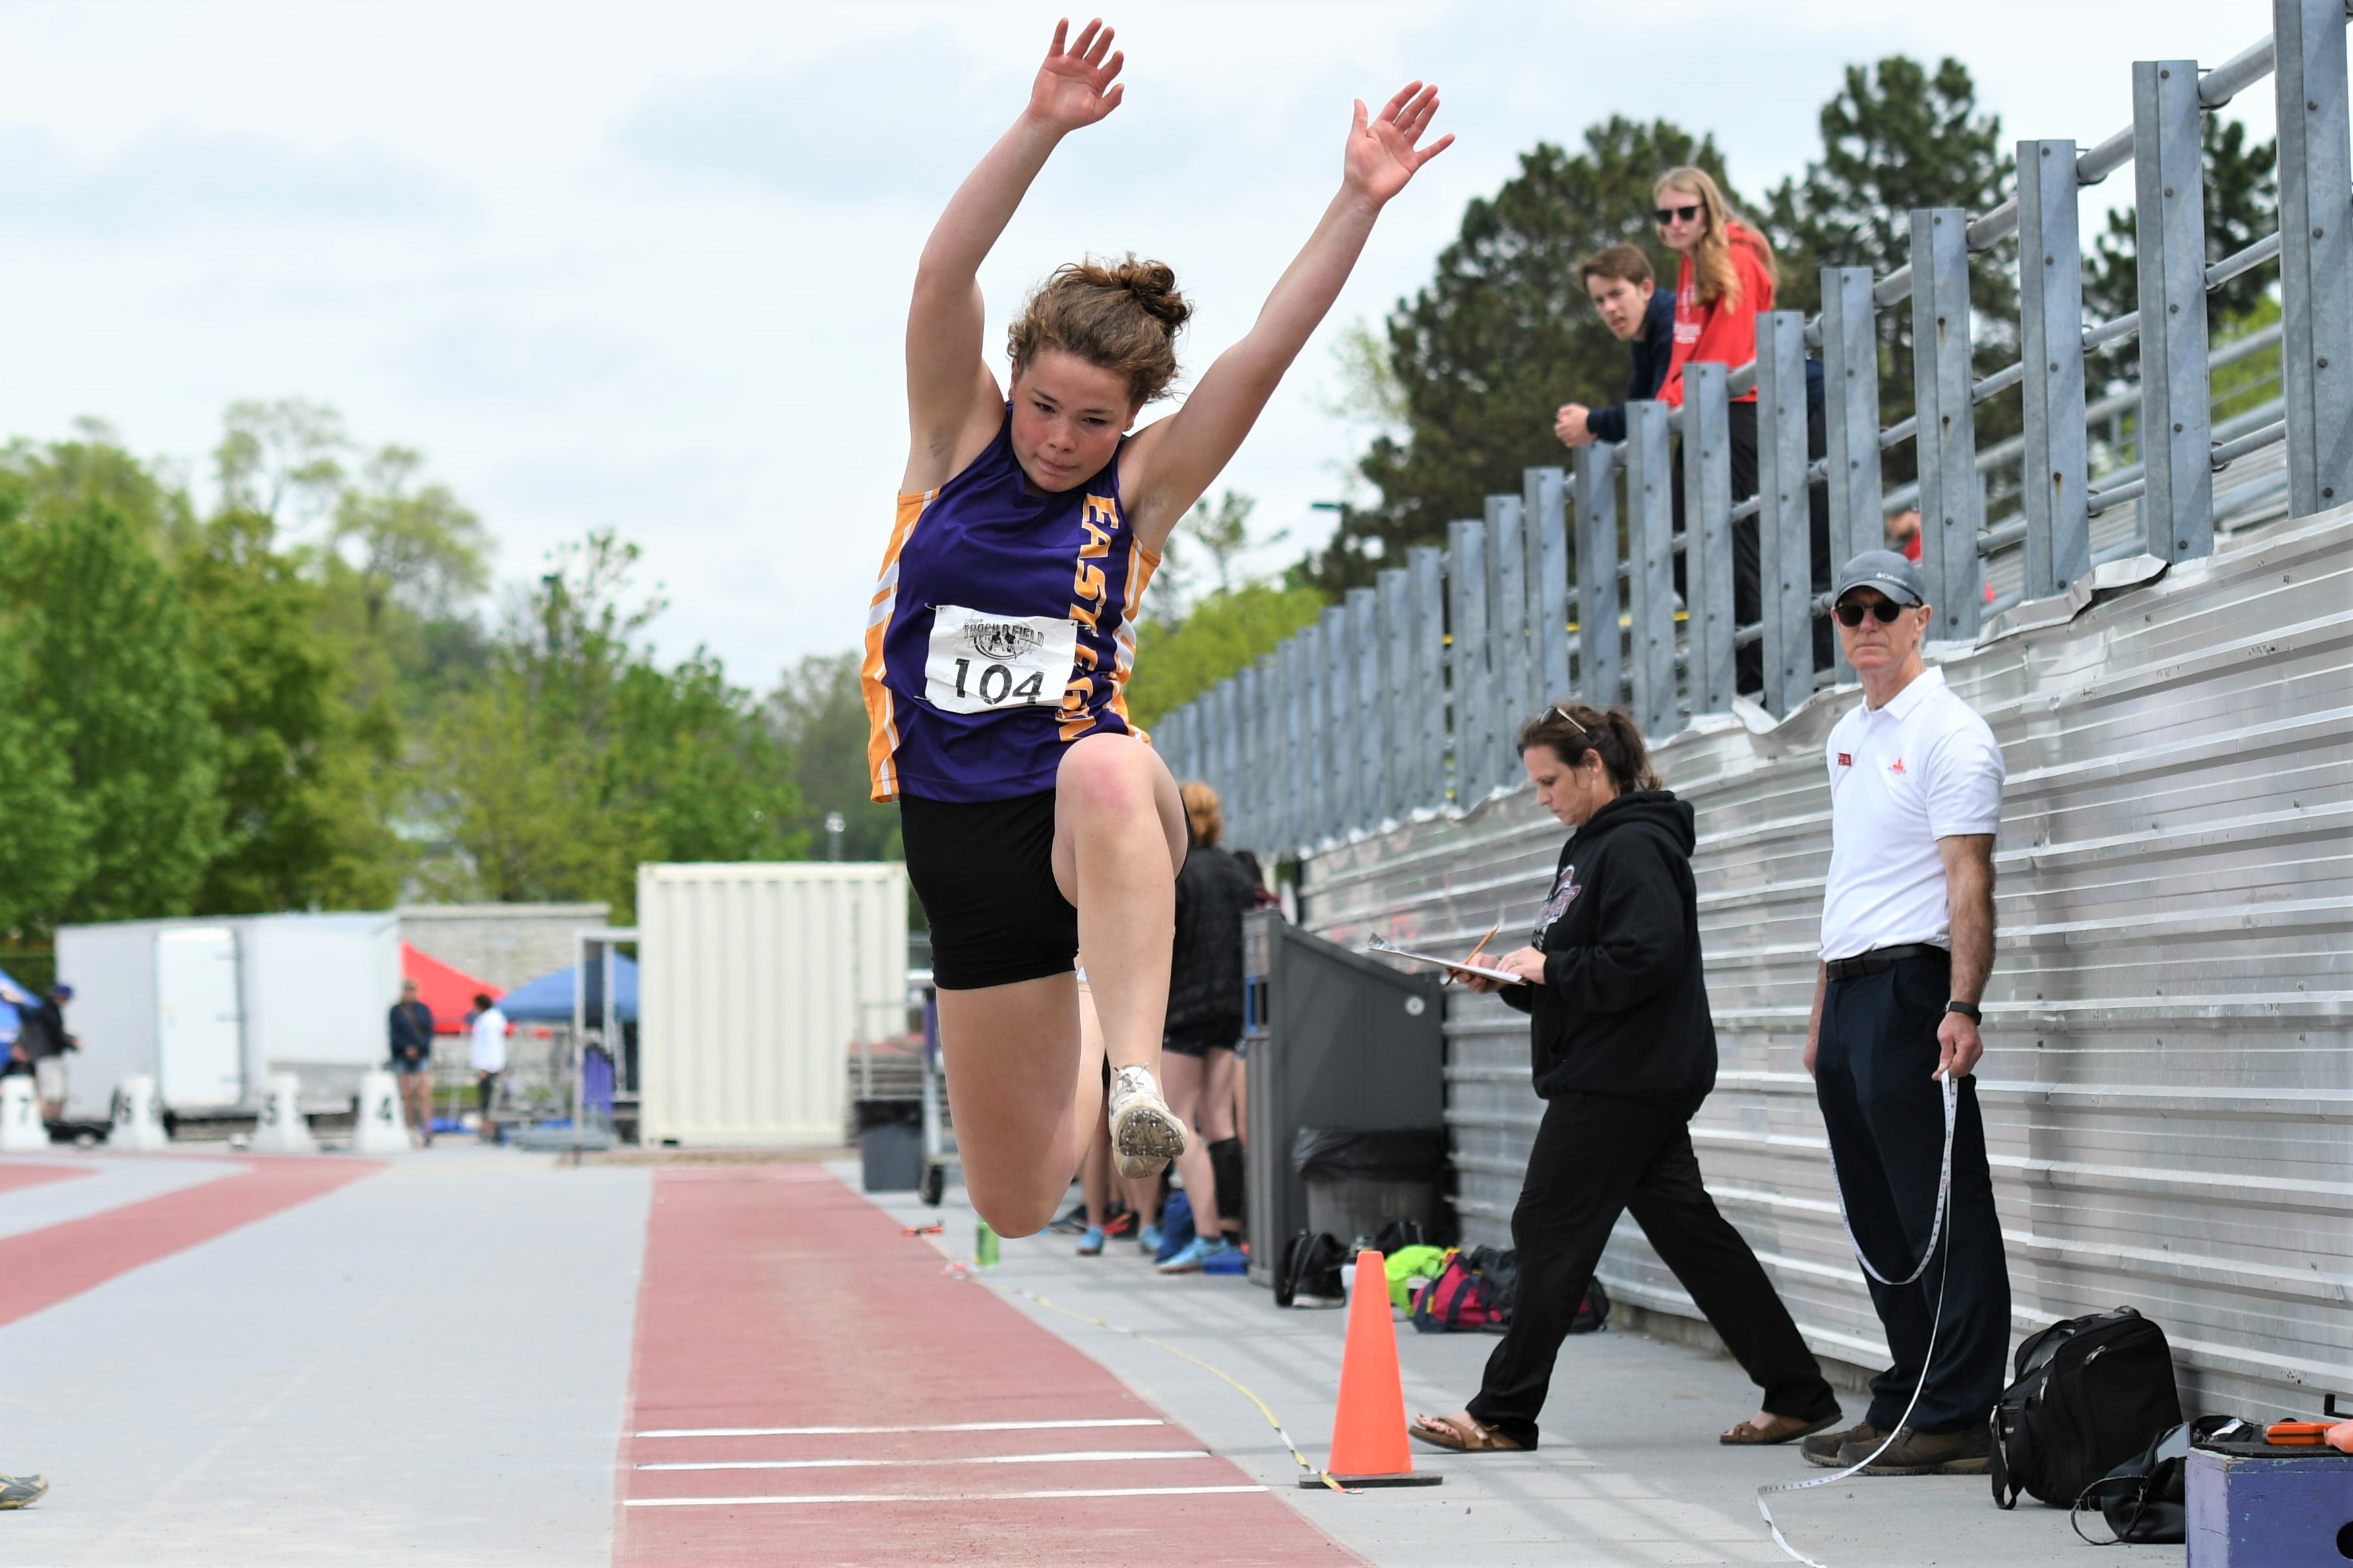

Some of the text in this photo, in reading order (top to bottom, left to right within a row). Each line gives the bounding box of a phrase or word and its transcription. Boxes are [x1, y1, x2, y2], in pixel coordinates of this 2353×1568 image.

[1068, 493, 1119, 637] EAST
[955, 658, 1045, 705] 104
[376, 1095, 393, 1126] 4
